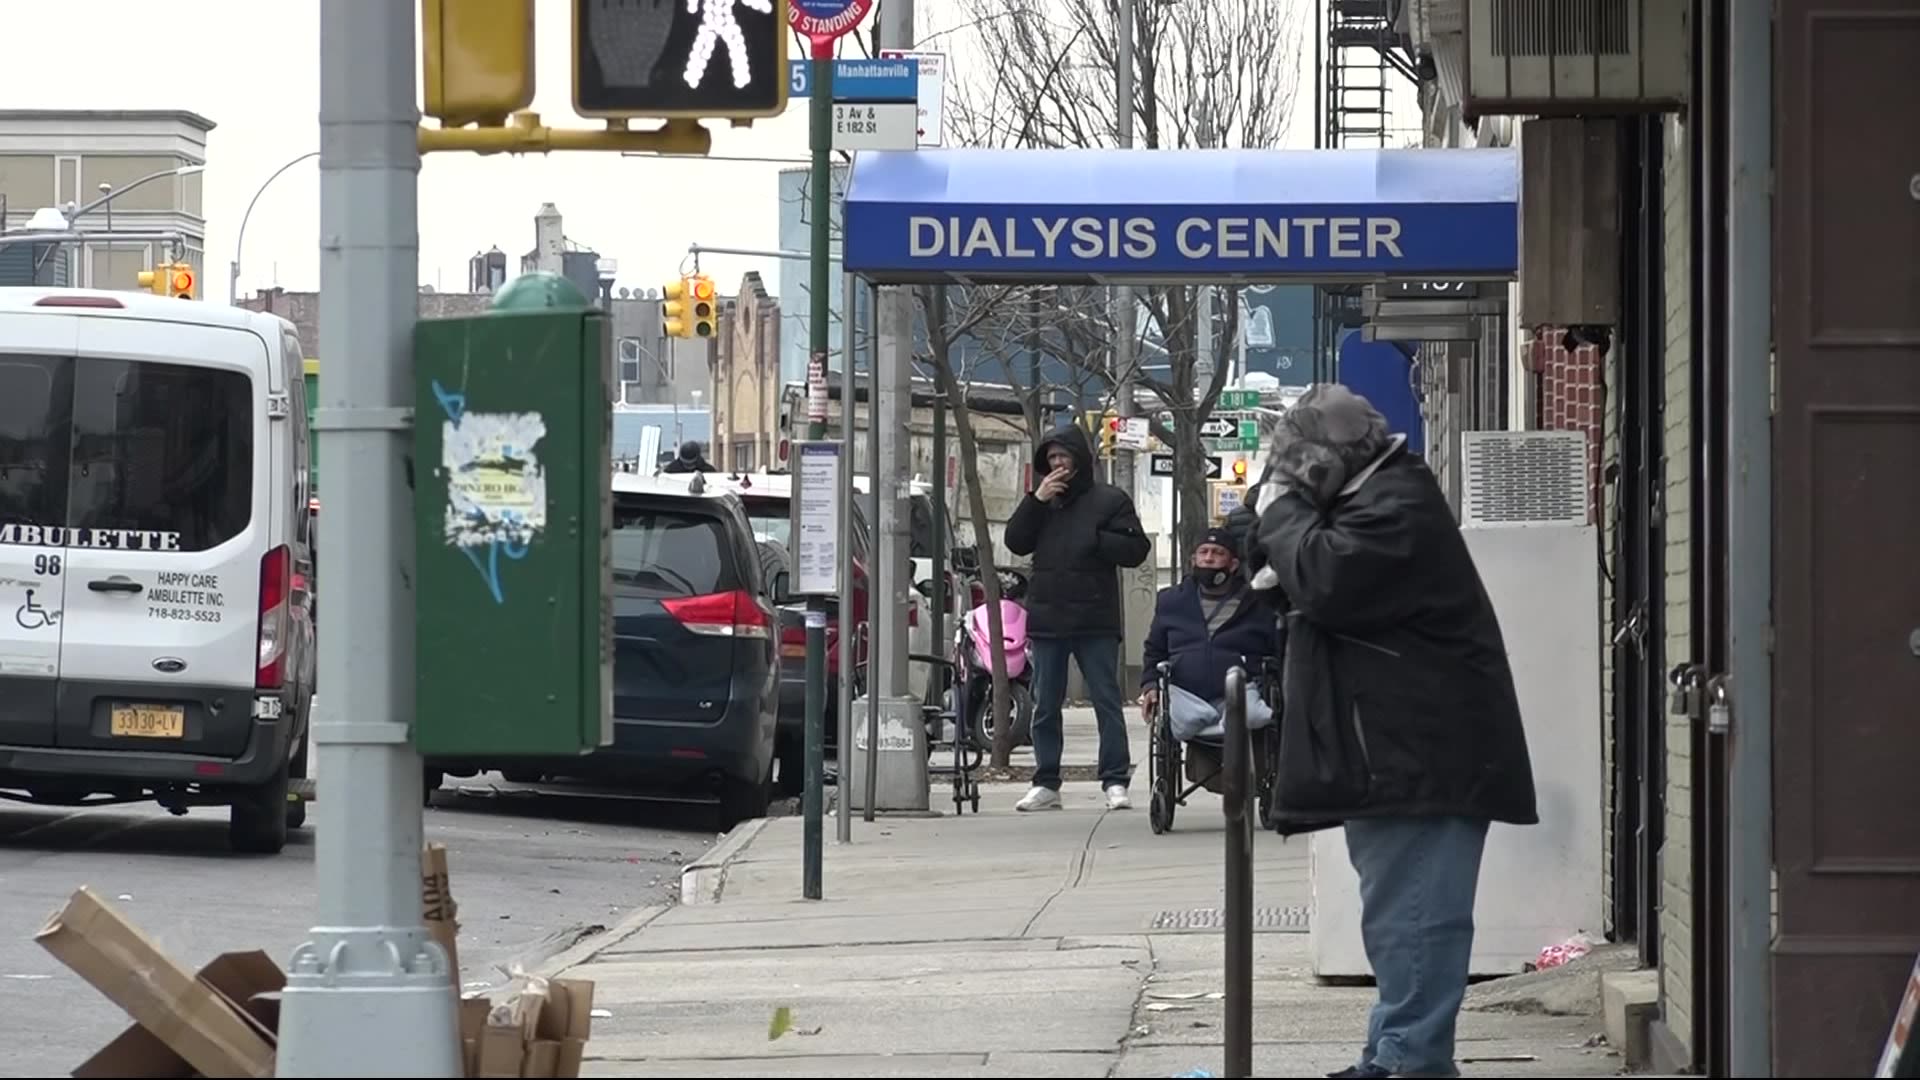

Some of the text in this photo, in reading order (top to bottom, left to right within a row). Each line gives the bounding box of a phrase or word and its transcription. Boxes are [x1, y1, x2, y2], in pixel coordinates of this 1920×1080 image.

[801, 1, 863, 34] STANDING
[837, 64, 910, 79] Manhattanville
[836, 106, 876, 120] 3 Av &
[837, 122, 877, 134] E 182 St
[909, 216, 1403, 259] DIALYSIS CENTER
[1209, 423, 1229, 432] WAY
[34, 554, 62, 577] 98
[157, 571, 219, 590] HAPPY CARE
[147, 587, 225, 607] AMBULETTE INC.
[148, 607, 221, 622] 718-823-5523
